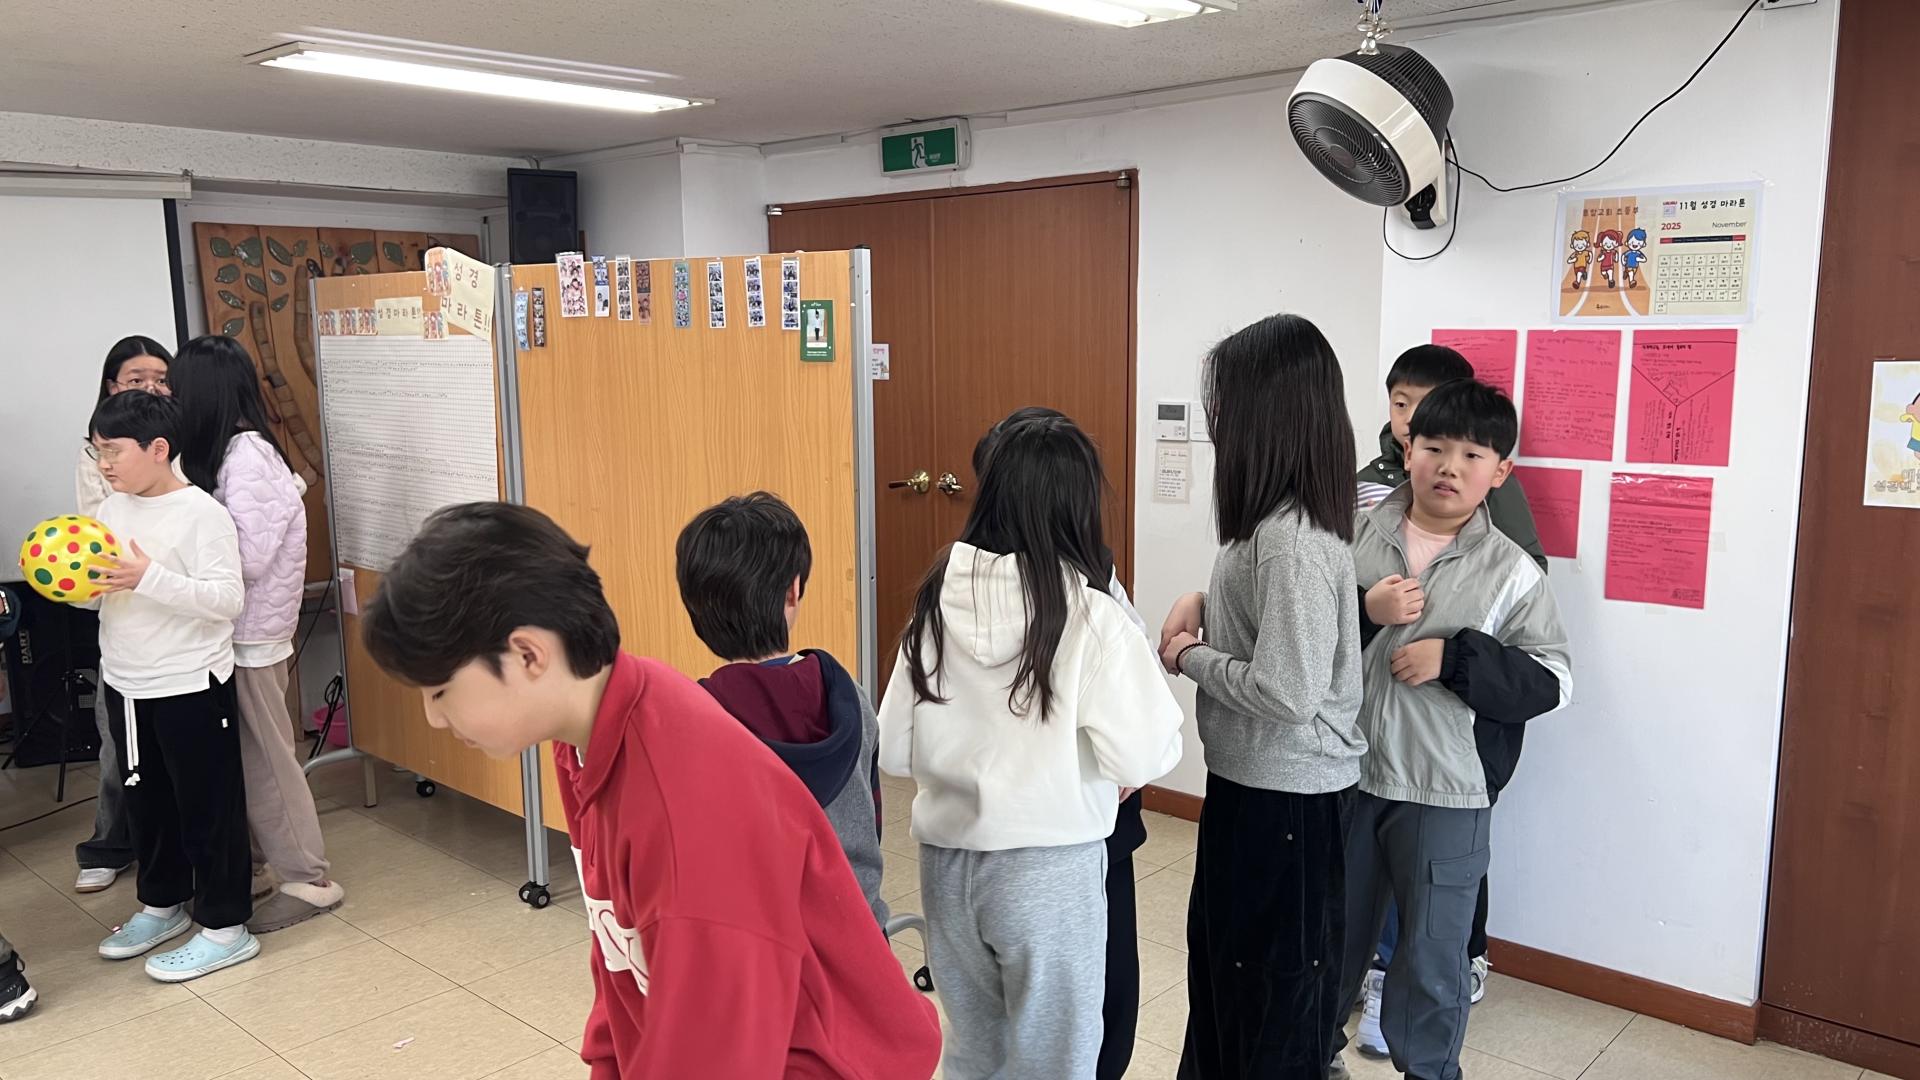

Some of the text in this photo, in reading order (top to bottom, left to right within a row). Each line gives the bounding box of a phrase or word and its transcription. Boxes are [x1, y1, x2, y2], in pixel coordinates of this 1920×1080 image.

[1680, 198, 1746, 211] 11월 성경 마라톤
[1661, 222, 1681, 231] 2025
[1712, 221, 1747, 229] November
[454, 262, 480, 289] 성경
